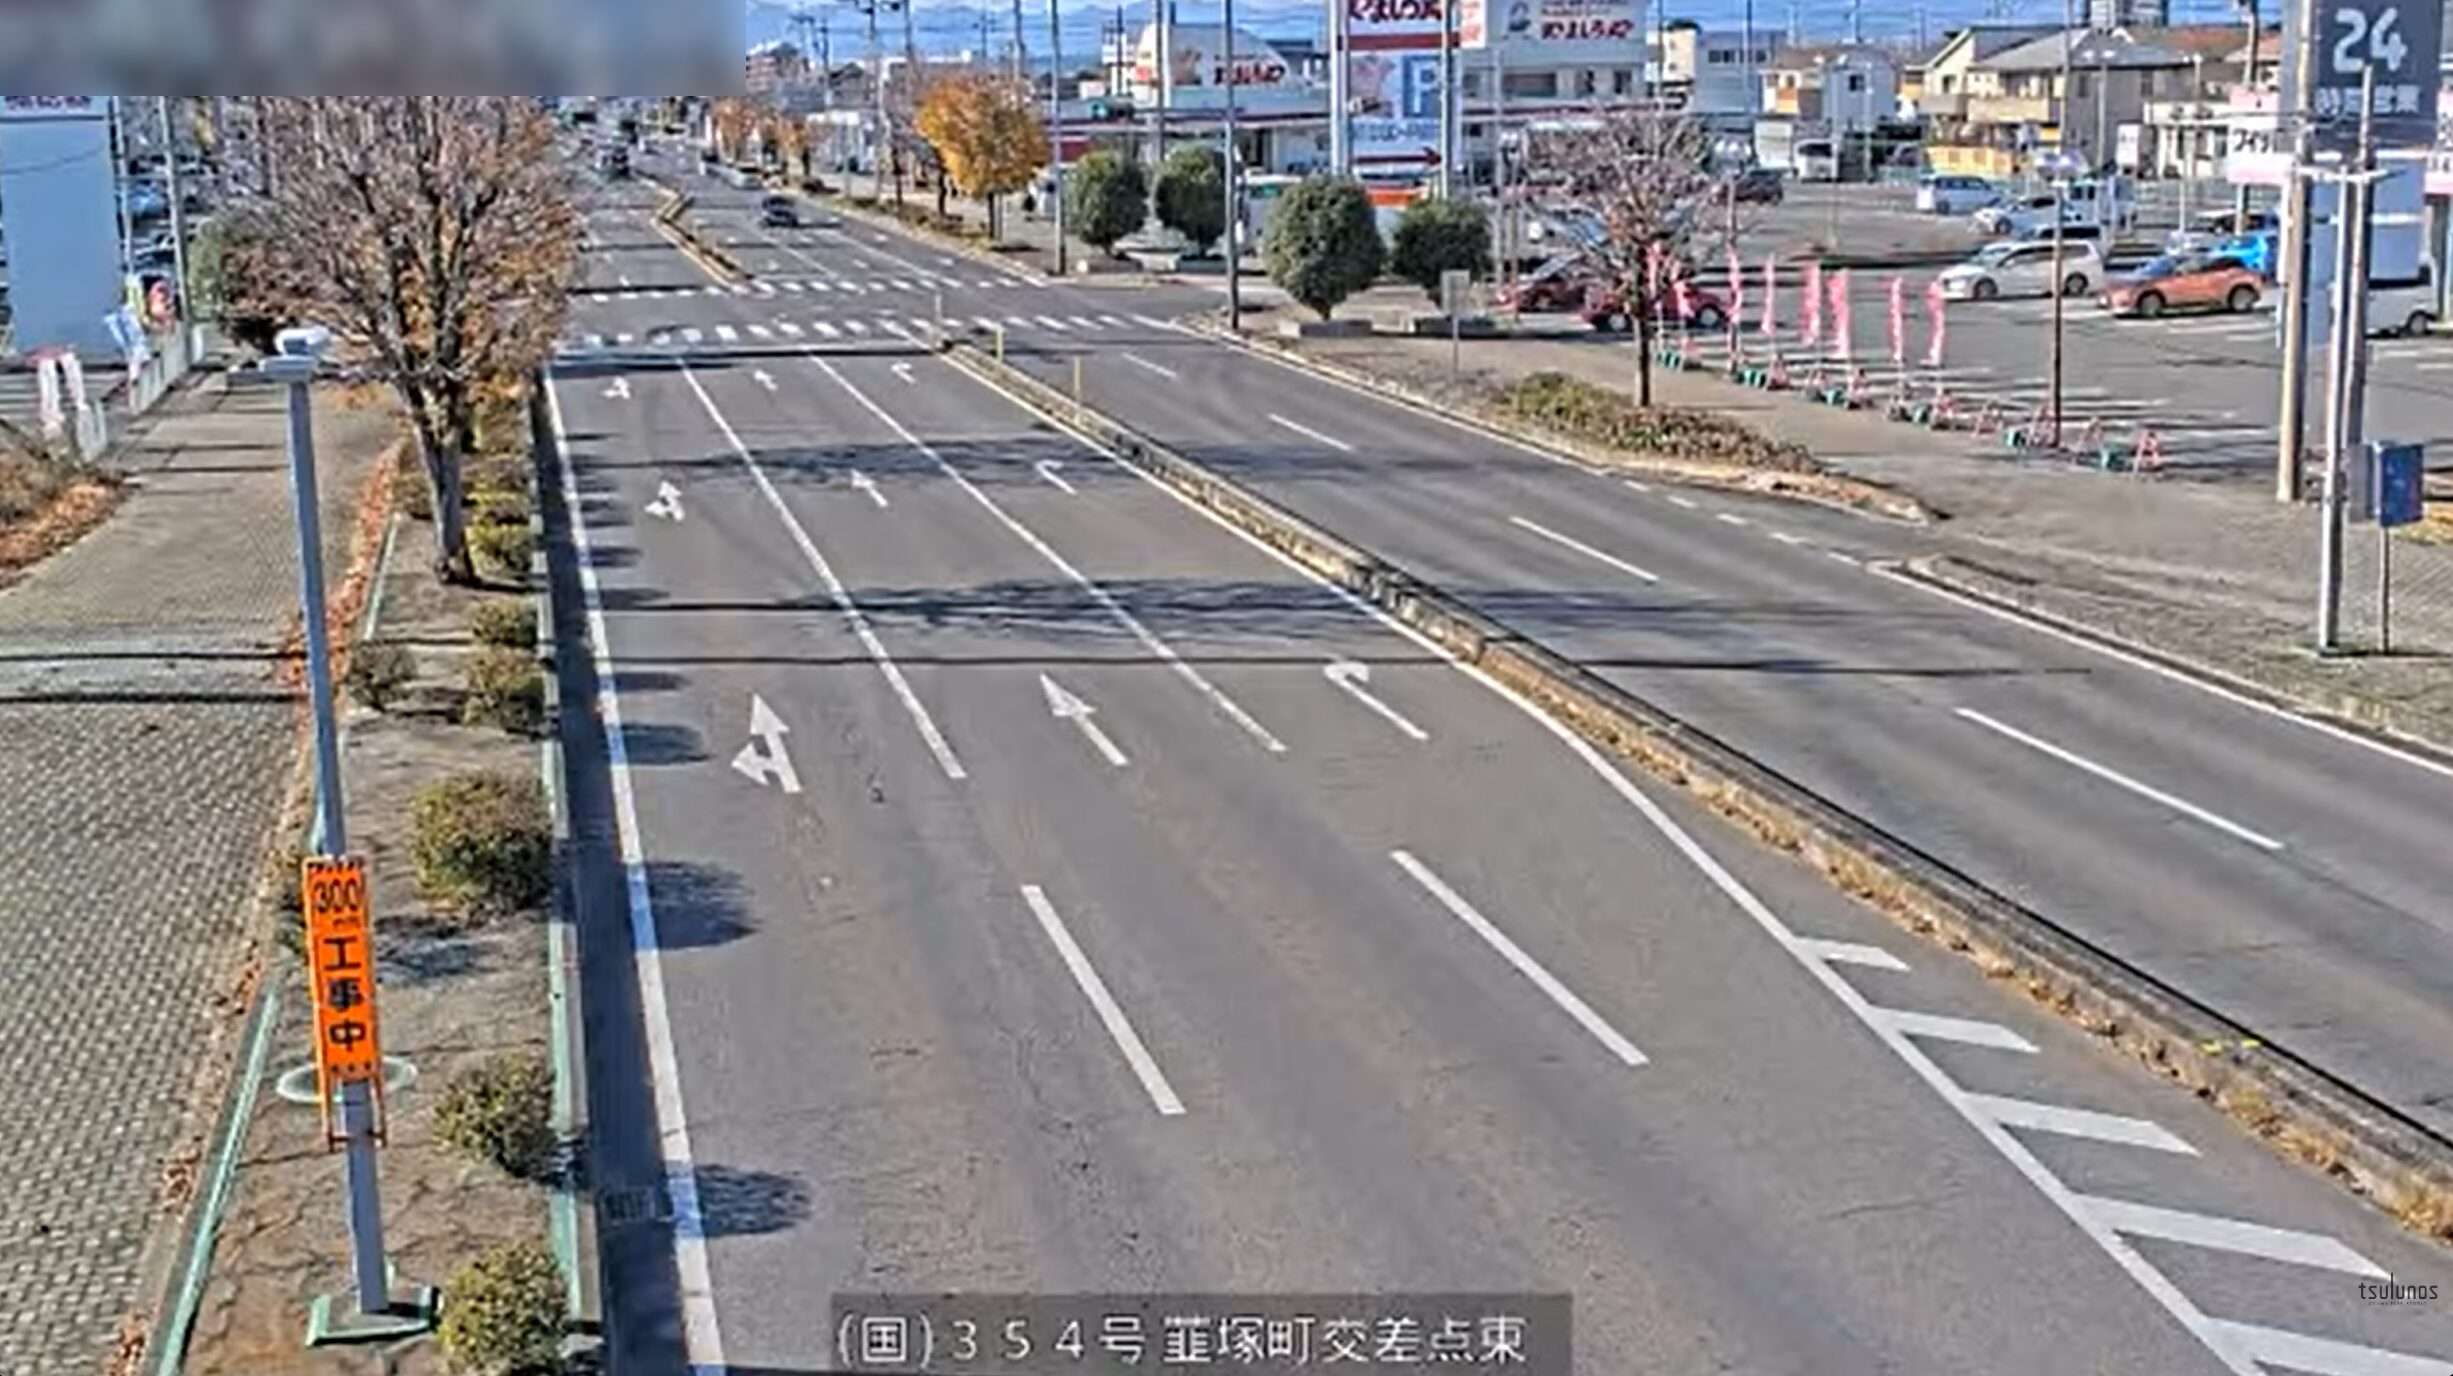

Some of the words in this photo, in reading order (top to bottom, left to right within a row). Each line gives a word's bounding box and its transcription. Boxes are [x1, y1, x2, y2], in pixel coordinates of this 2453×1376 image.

[2334, 8, 2408, 72] 24
[313, 877, 366, 913] 300
[324, 935, 366, 1051] 工事中
